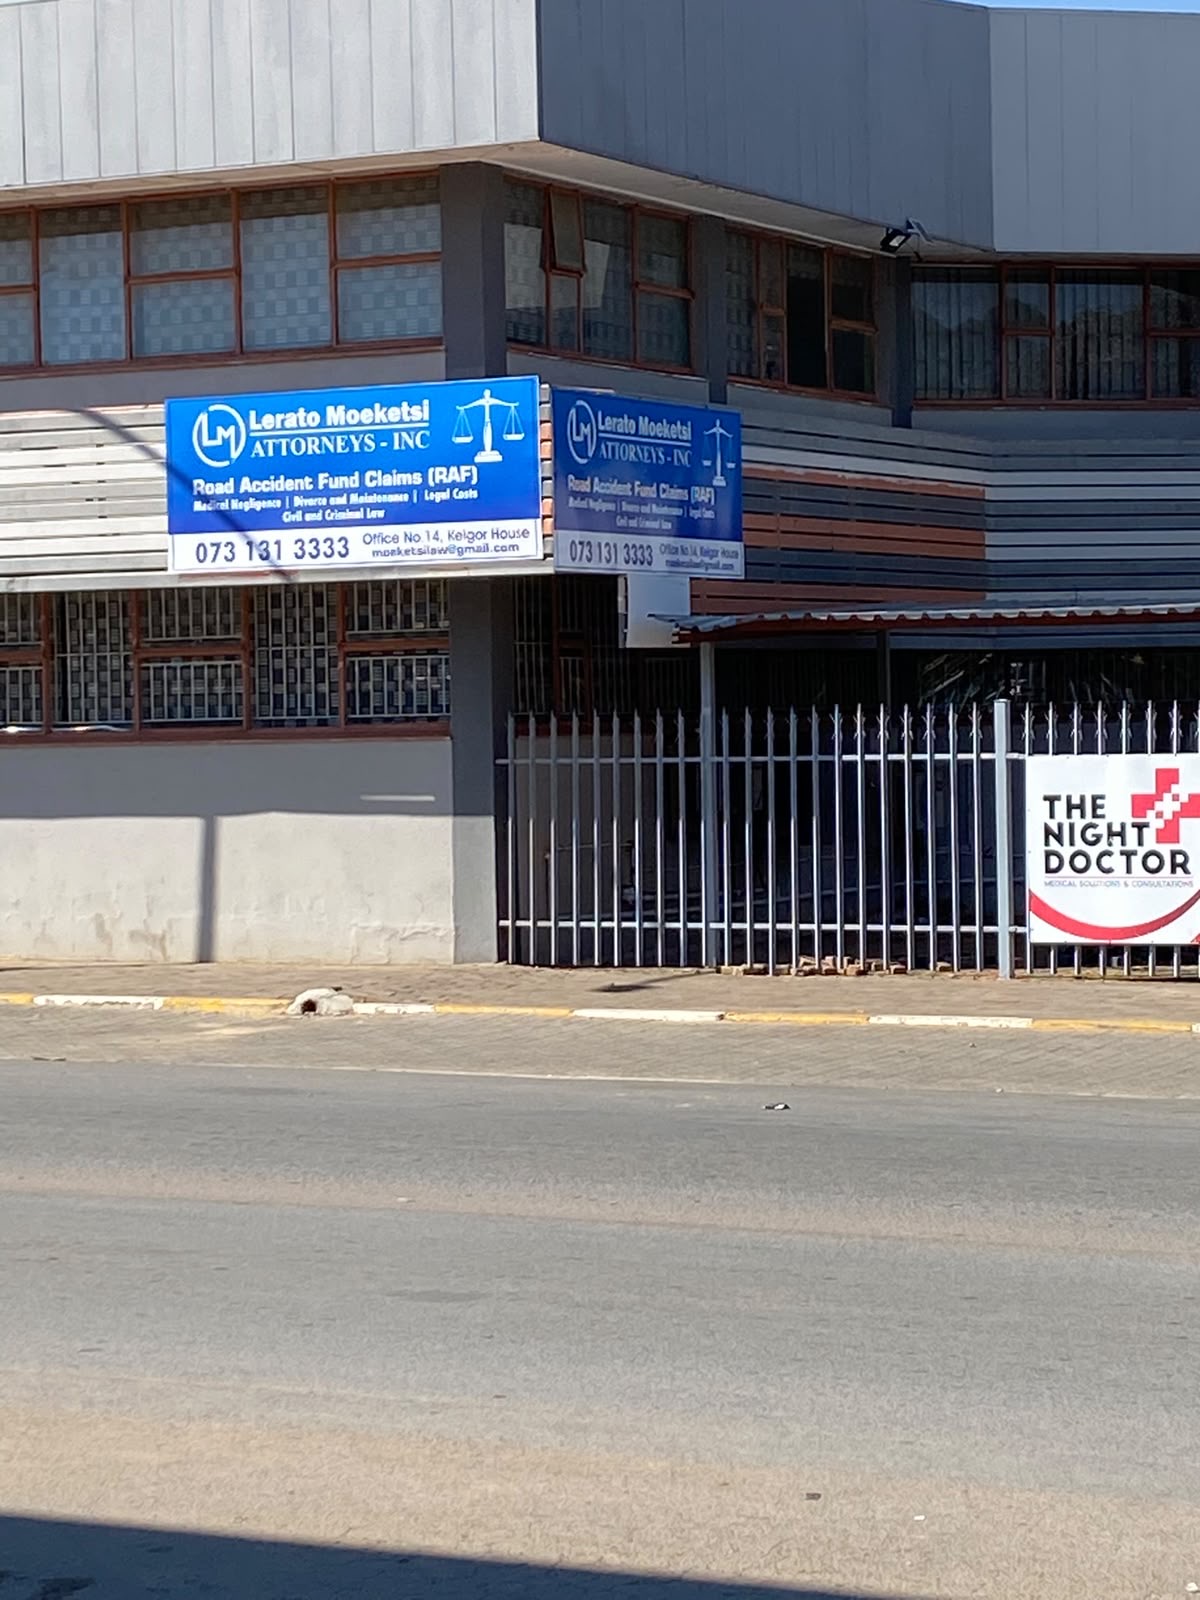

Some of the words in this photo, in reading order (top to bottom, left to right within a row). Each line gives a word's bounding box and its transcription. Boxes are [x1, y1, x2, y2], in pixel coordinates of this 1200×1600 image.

[249, 407, 321, 430] Lerato
[326, 399, 430, 427] Moeketsi
[597, 410, 636, 435] Lerato
[638, 415, 692, 441] Moeketsi
[250, 433, 376, 458] ATTORNEYS
[393, 430, 430, 450] INC
[600, 441, 665, 465] ATTORNEYS
[673, 448, 693, 468] INC
[192, 477, 234, 496] Road
[239, 475, 314, 494] Accident
[318, 472, 360, 490] Fund
[364, 469, 423, 487] Claims
[427, 465, 478, 487] (RAF)
[567, 474, 590, 493] Road
[593, 477, 632, 496] Accident
[634, 481, 657, 498] Fund
[659, 483, 689, 501] Claims
[231, 497, 282, 512] Negligence
[293, 495, 328, 507] Divorce
[329, 493, 348, 505] and
[349, 492, 409, 504] Maintenance
[424, 488, 450, 503] Legal
[452, 488, 479, 500] Costs
[282, 510, 303, 522] Civil
[304, 510, 323, 521] and
[324, 508, 364, 520] Criminal
[366, 508, 385, 519] Law
[195, 541, 236, 563] 073
[247, 539, 282, 561] 131
[294, 536, 350, 560] 3333
[362, 532, 400, 545] Office
[491, 528, 530, 540] House
[569, 539, 593, 563] 073
[597, 541, 618, 564] 131
[623, 543, 654, 566] 3333
[1042, 794, 1106, 820] THE
[1043, 821, 1150, 847] NIGHT
[1044, 849, 1192, 875] DOCTOR
[1044, 880, 1077, 888] MEDICAL
[1080, 880, 1122, 888] SOLUTIONS
[1124, 880, 1129, 888] &
[1132, 880, 1194, 888] CONSULTATIONS
